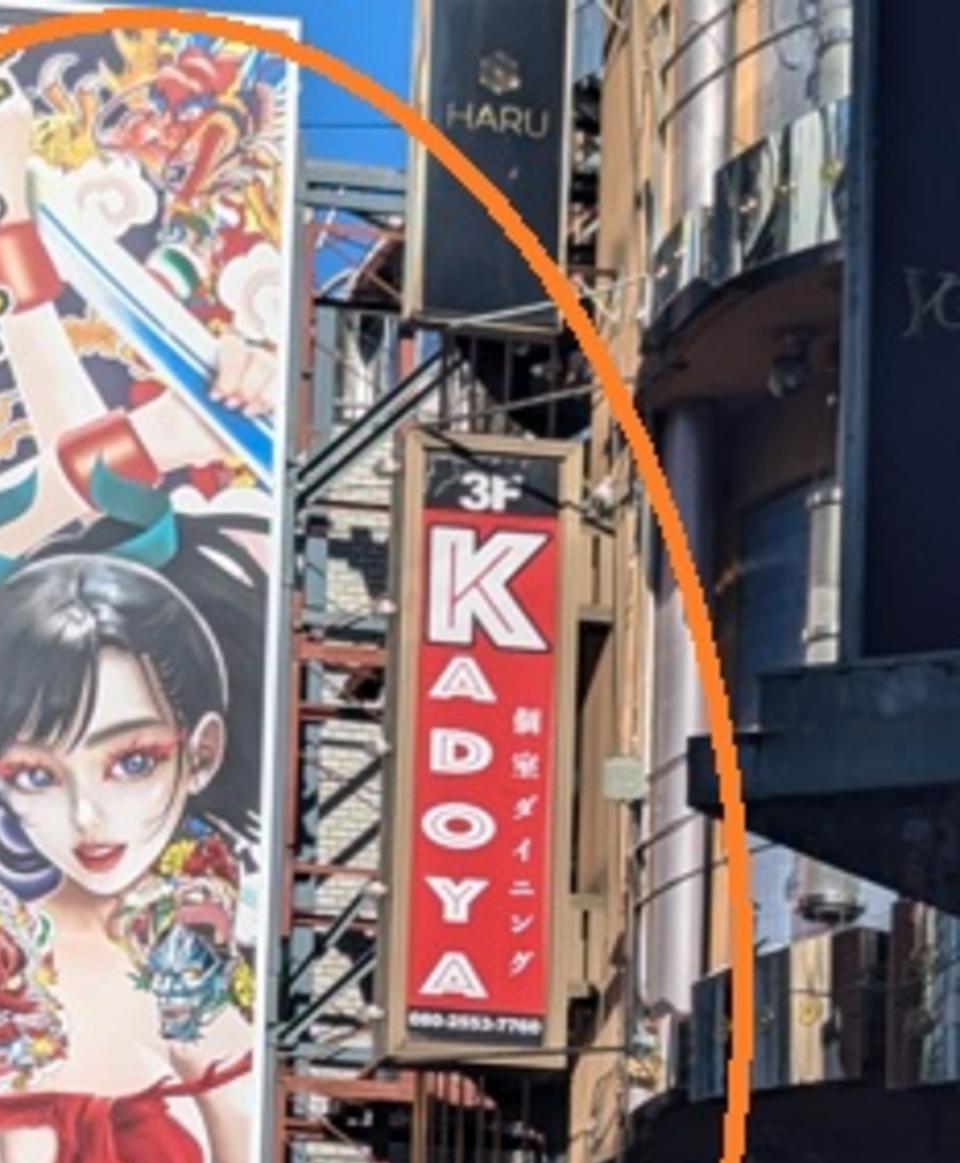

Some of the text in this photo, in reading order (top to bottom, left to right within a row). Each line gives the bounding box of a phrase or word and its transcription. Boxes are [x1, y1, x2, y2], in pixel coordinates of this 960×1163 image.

[446, 102, 550, 138] HARU
[459, 471, 524, 512] 3F
[419, 525, 549, 999] KADOYA
